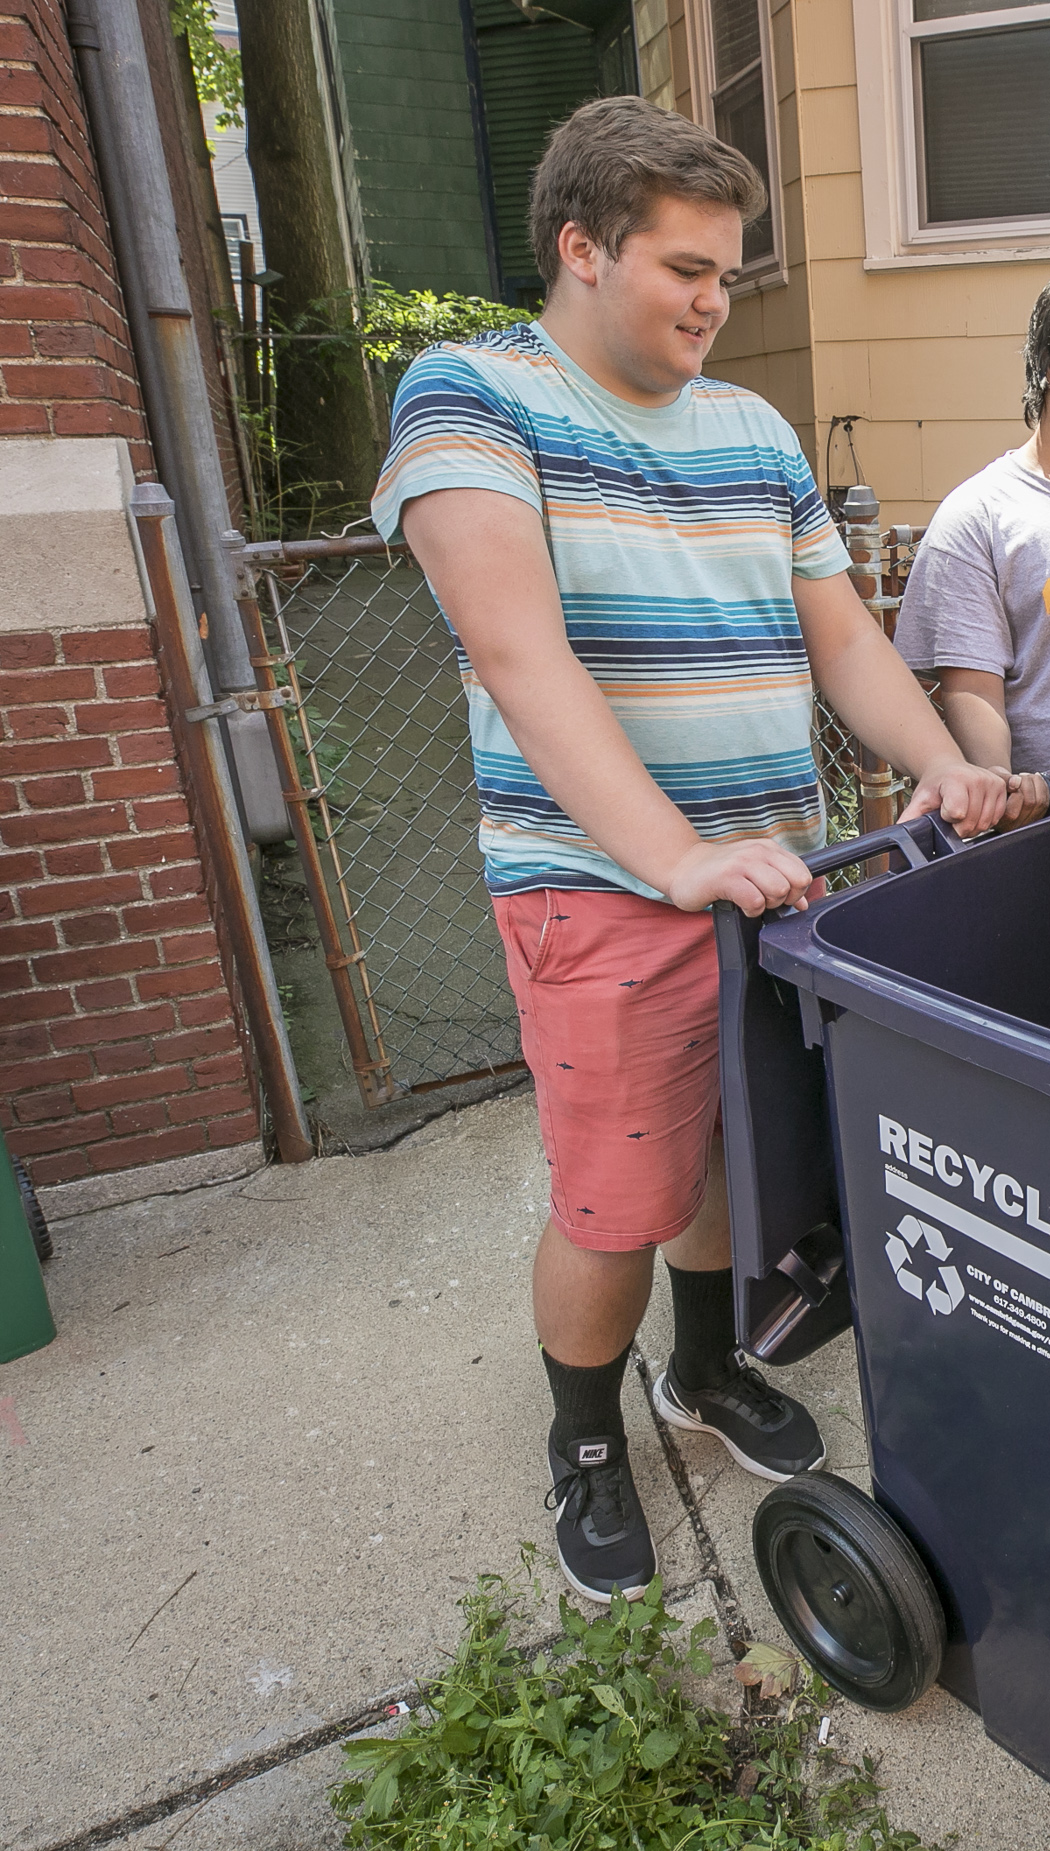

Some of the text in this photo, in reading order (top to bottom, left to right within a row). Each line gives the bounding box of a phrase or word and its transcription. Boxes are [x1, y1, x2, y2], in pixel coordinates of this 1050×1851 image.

[966, 1264, 991, 1285] CITY
[993, 1279, 1009, 1294] OF
[970, 1307, 988, 1323] Thank
[988, 1319, 999, 1329] you
[999, 1325, 1009, 1335] for
[1009, 1331, 1031, 1349] making
[993, 1295, 1047, 1330] 617.349.4800
[582, 1448, 605, 1459] NIKE
